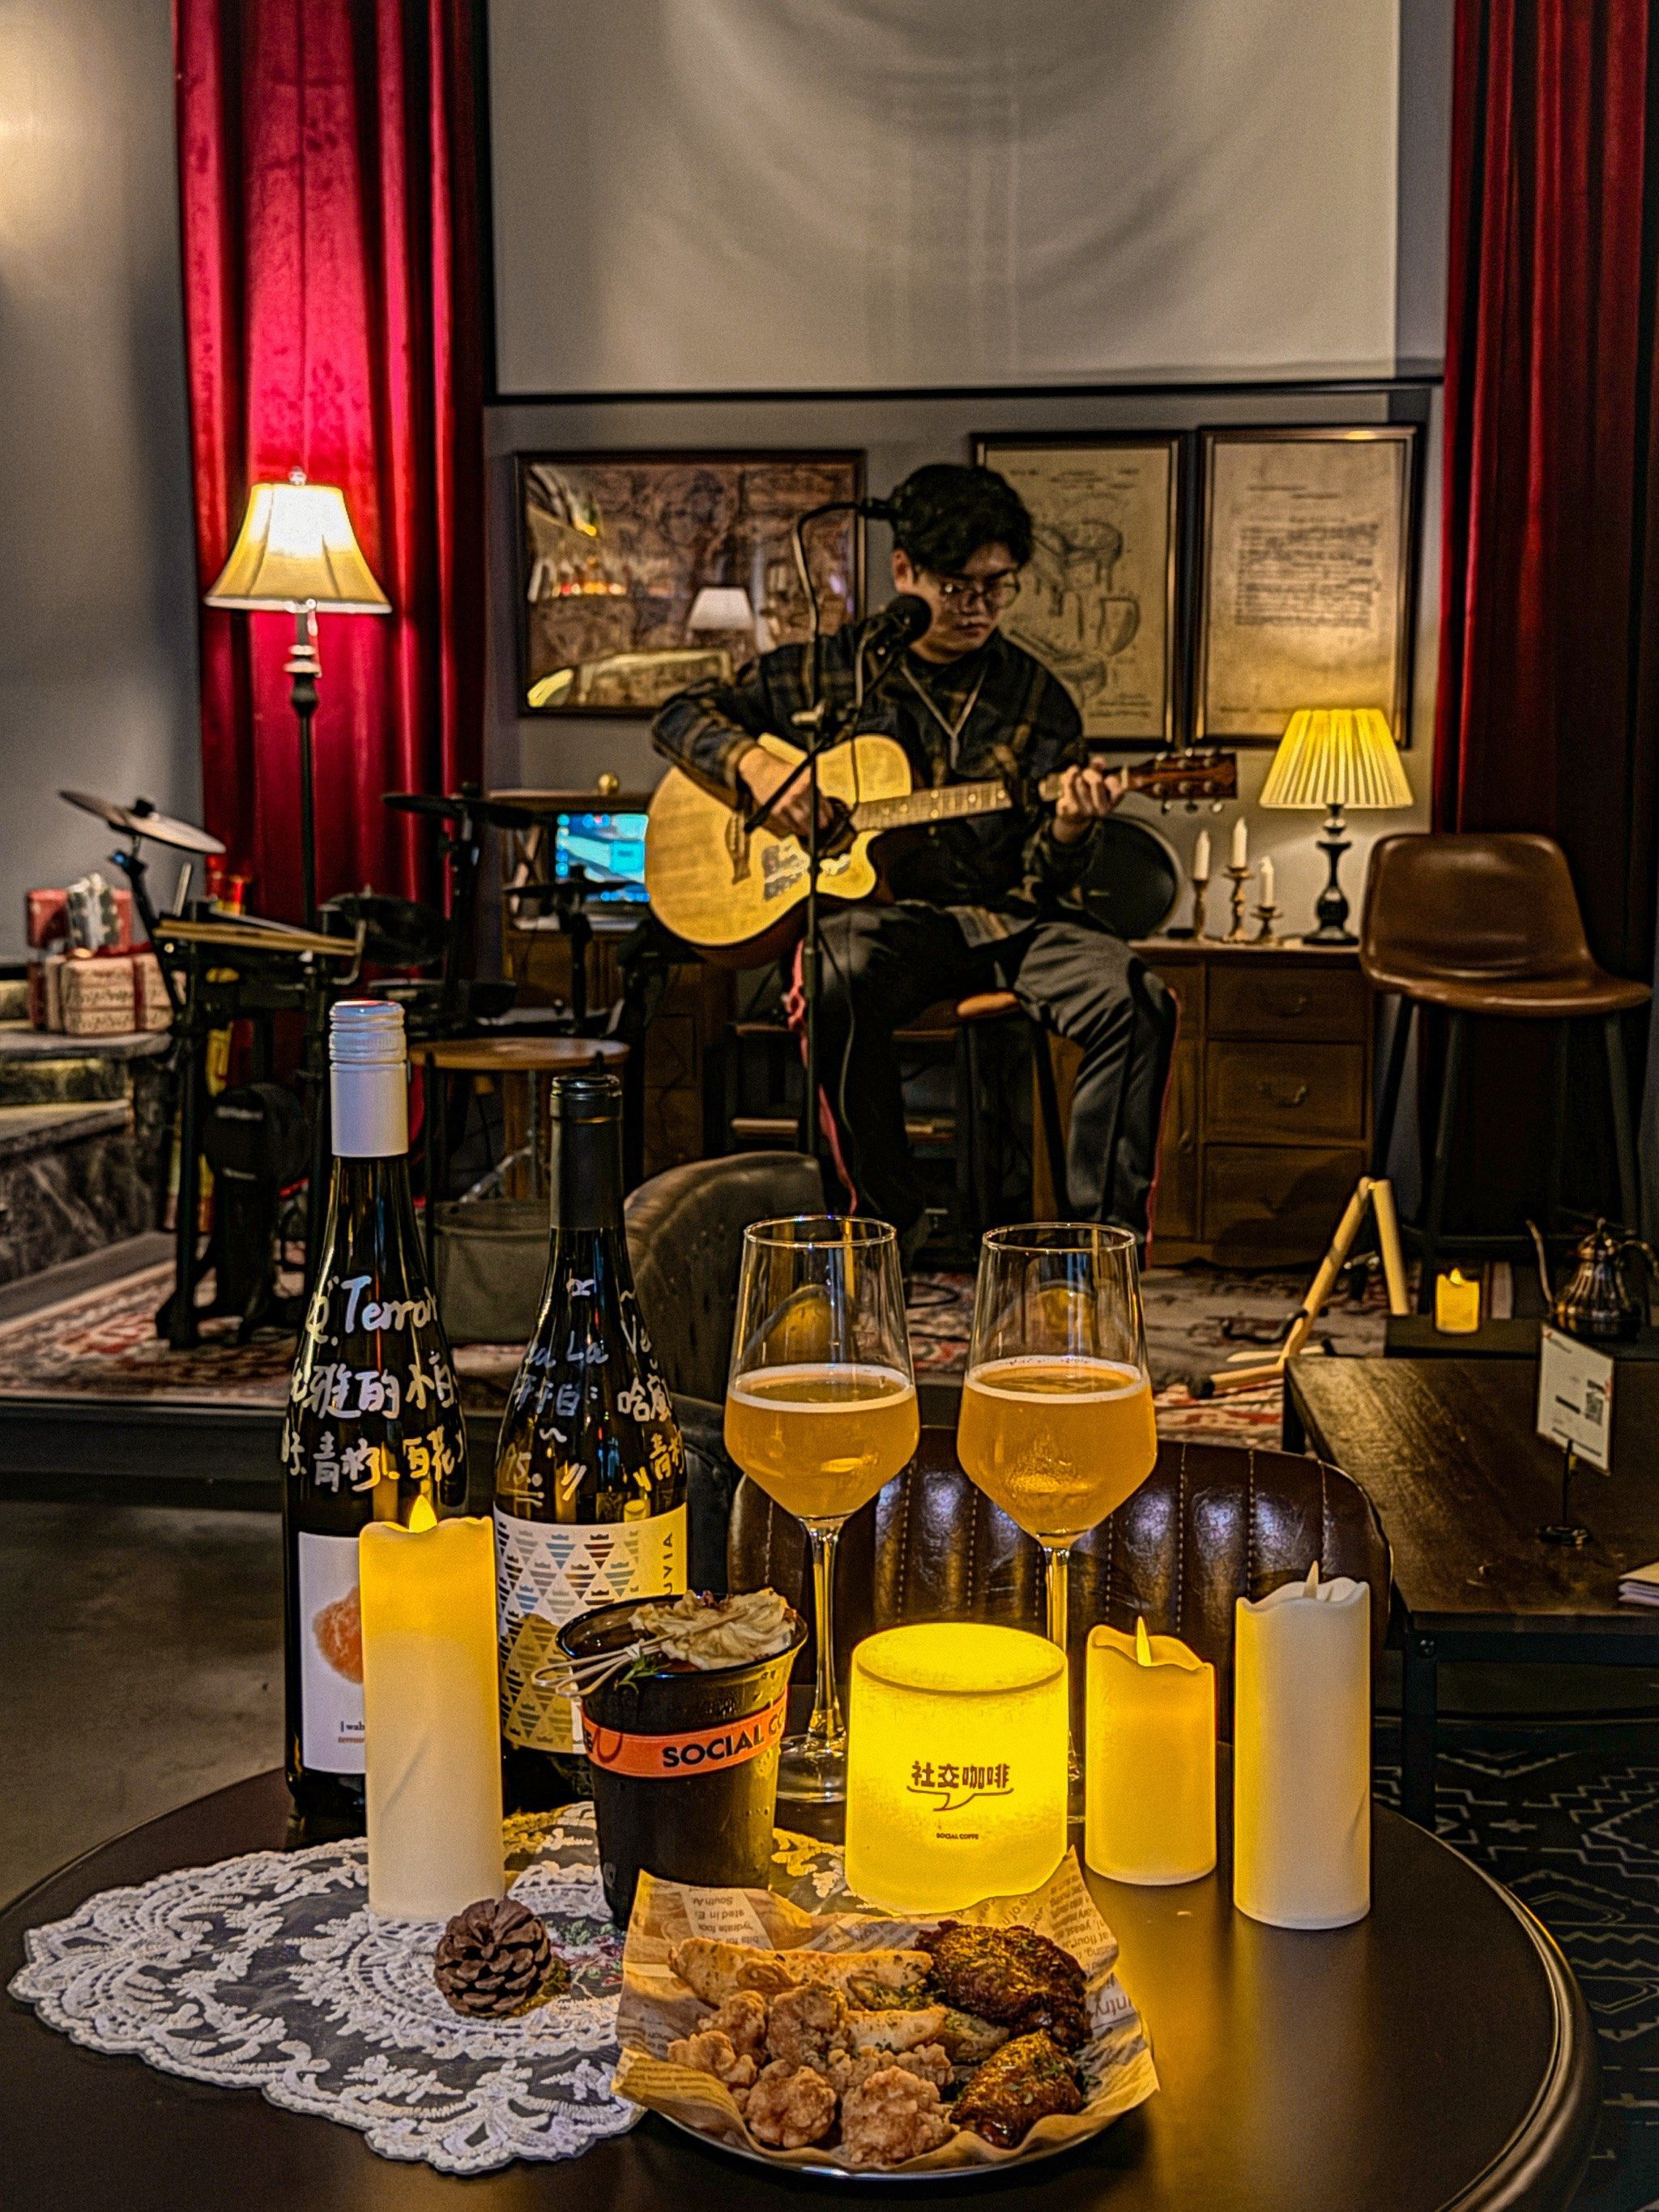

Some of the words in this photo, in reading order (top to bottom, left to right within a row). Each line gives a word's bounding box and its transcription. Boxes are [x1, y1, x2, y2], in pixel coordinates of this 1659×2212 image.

[662, 1724, 765, 1768] SOCIAL
[911, 1760, 1011, 1789] 社交咖啡
[936, 1832, 959, 1840] SOCIAL
